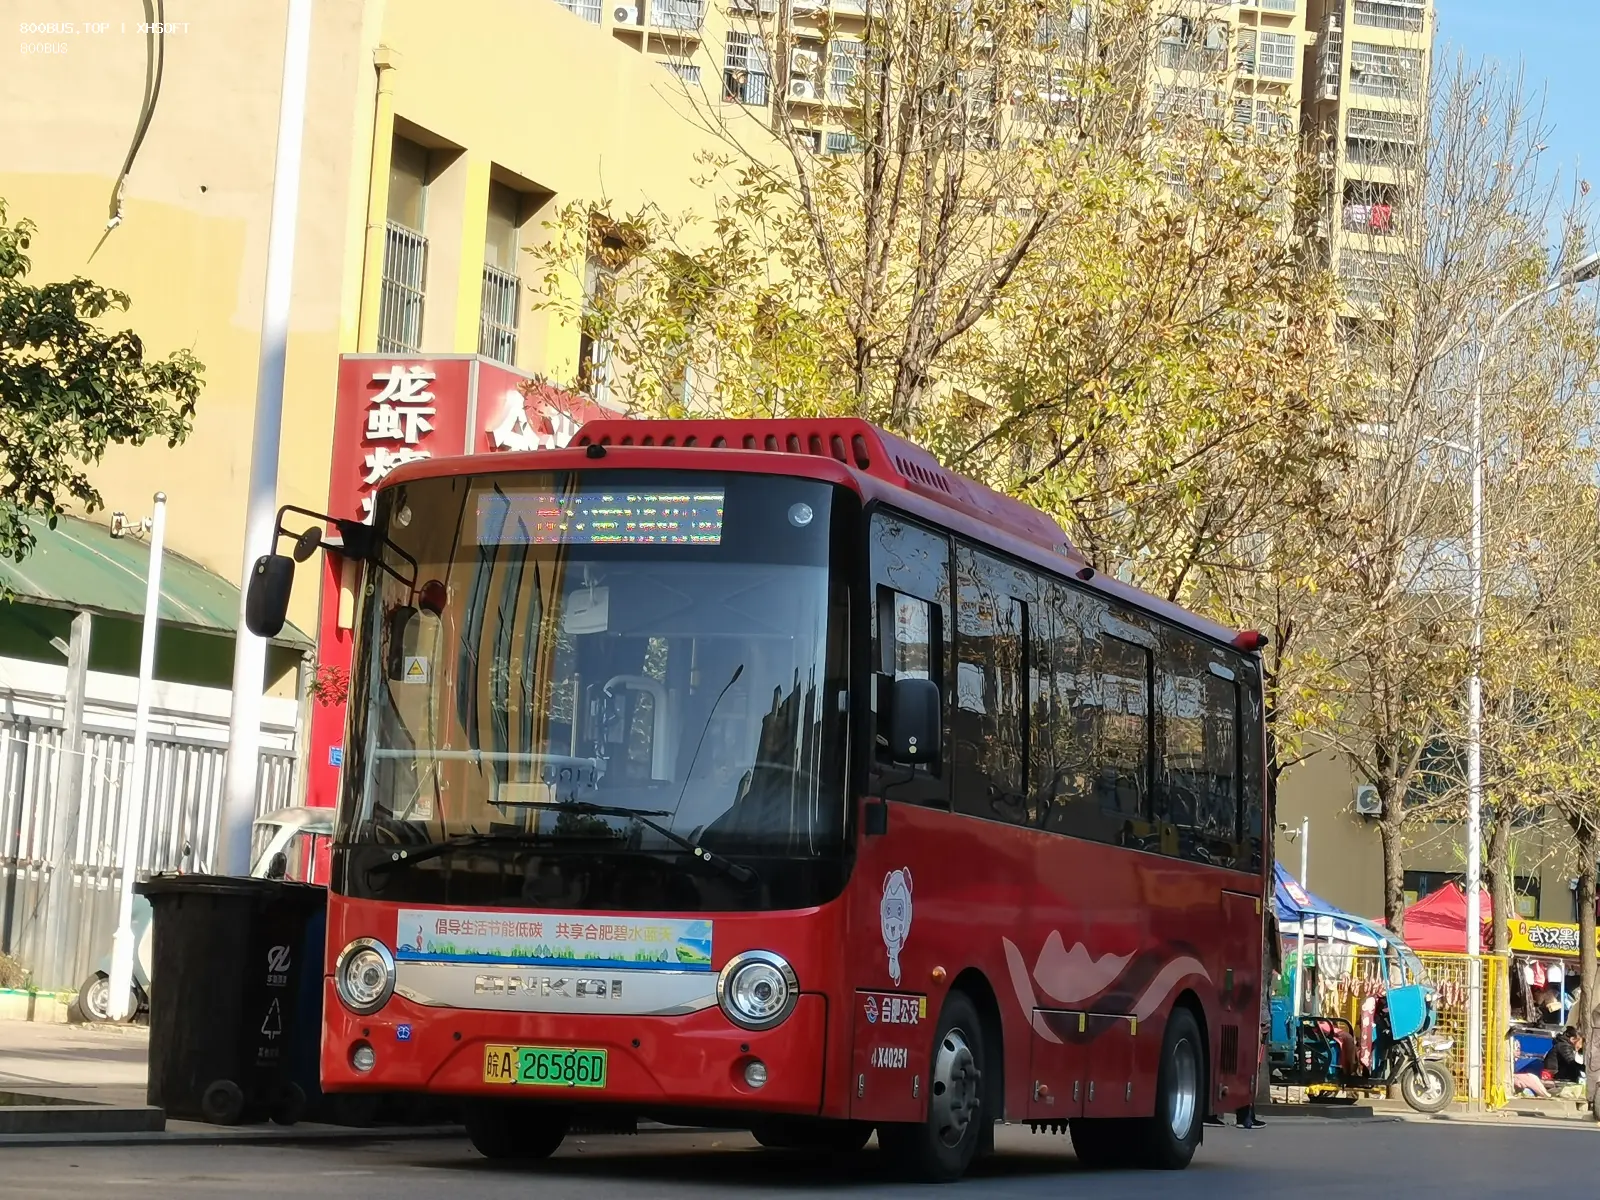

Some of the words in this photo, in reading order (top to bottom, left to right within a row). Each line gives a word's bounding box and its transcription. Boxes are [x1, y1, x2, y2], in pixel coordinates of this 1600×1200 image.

[361, 365, 436, 526] 龙虾
[435, 918, 543, 938] 倡导生活节能低碳
[555, 922, 673, 942] 共享合肥碧水蓝天
[474, 975, 623, 999] ANKAI
[881, 997, 919, 1024] 合肥公交
[486, 1051, 513, 1079] 皖A
[523, 1053, 604, 1083] 26586D
